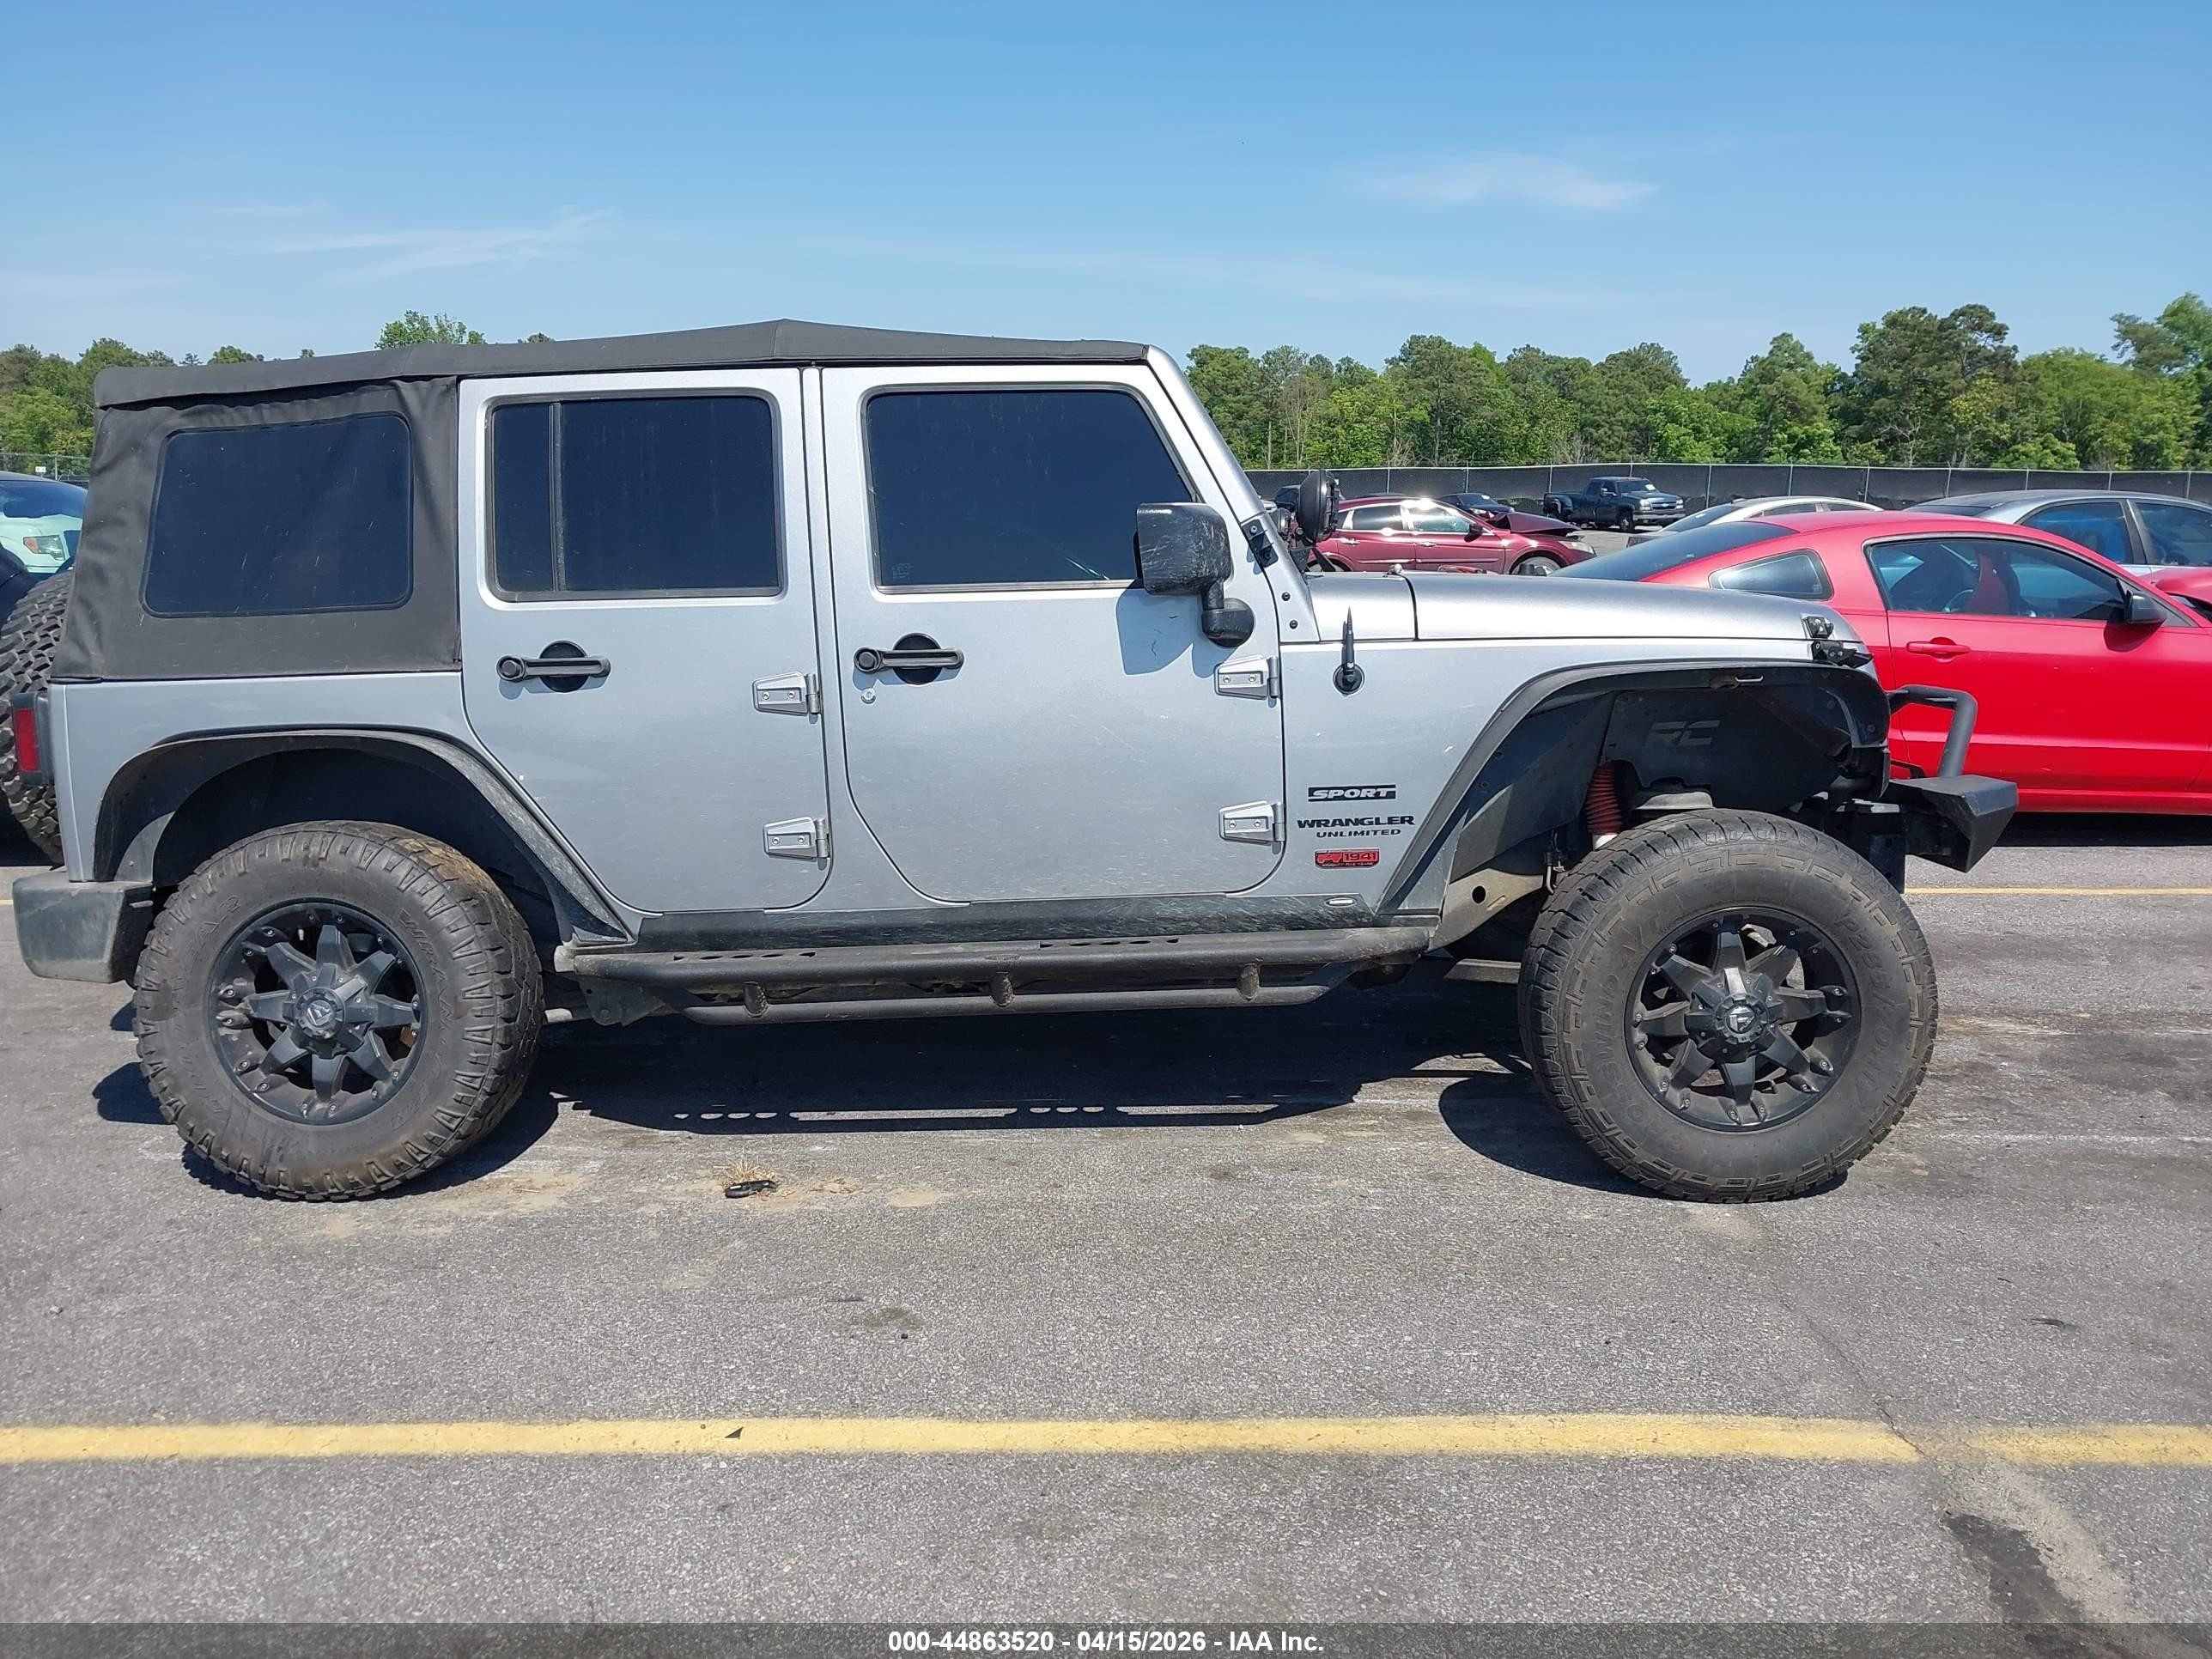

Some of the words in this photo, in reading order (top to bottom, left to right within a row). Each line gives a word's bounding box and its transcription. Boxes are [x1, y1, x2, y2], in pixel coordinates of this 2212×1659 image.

[1310, 786, 1395, 800] SPORT
[1297, 815, 1415, 829] WRANGLER
[1316, 829, 1401, 838] UNLIMITED
[1344, 852, 1376, 861] 1941
